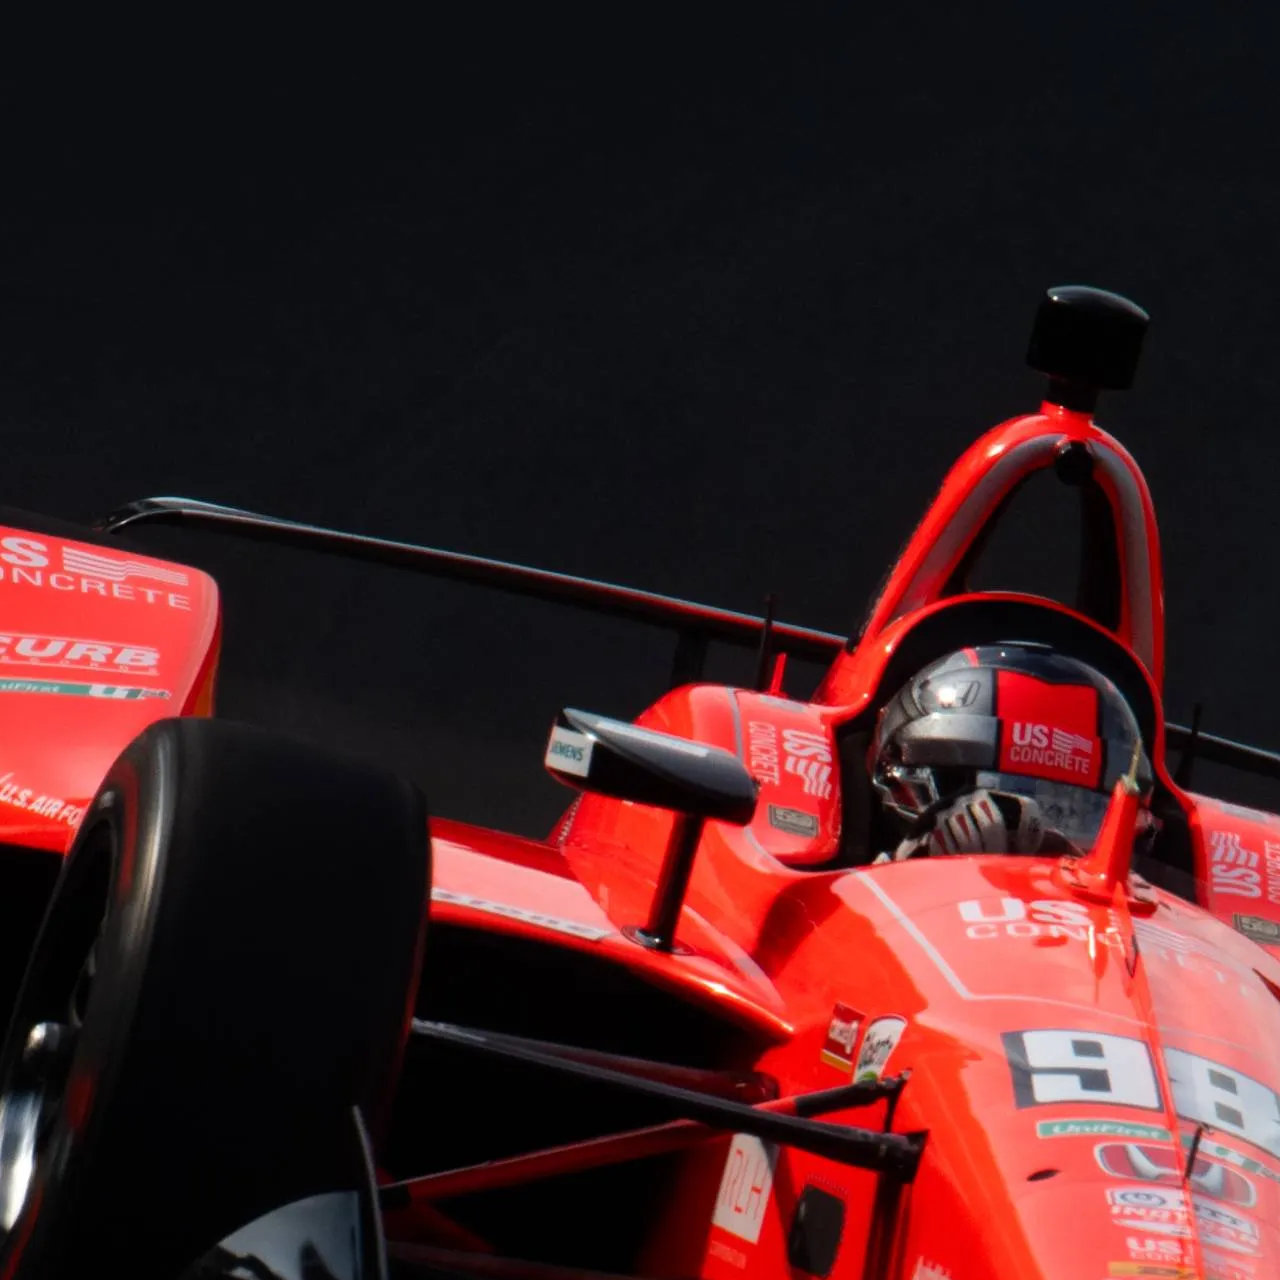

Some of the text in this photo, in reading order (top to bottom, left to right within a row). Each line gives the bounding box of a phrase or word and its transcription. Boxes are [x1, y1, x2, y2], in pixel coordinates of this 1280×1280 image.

[782, 729, 832, 762] US
[1012, 722, 1049, 748] US
[1010, 746, 1090, 775] CONCRETE
[27, 795, 65, 819] AIR
[57, 804, 84, 829] FO
[1212, 864, 1262, 897] US
[957, 897, 1092, 927] US
